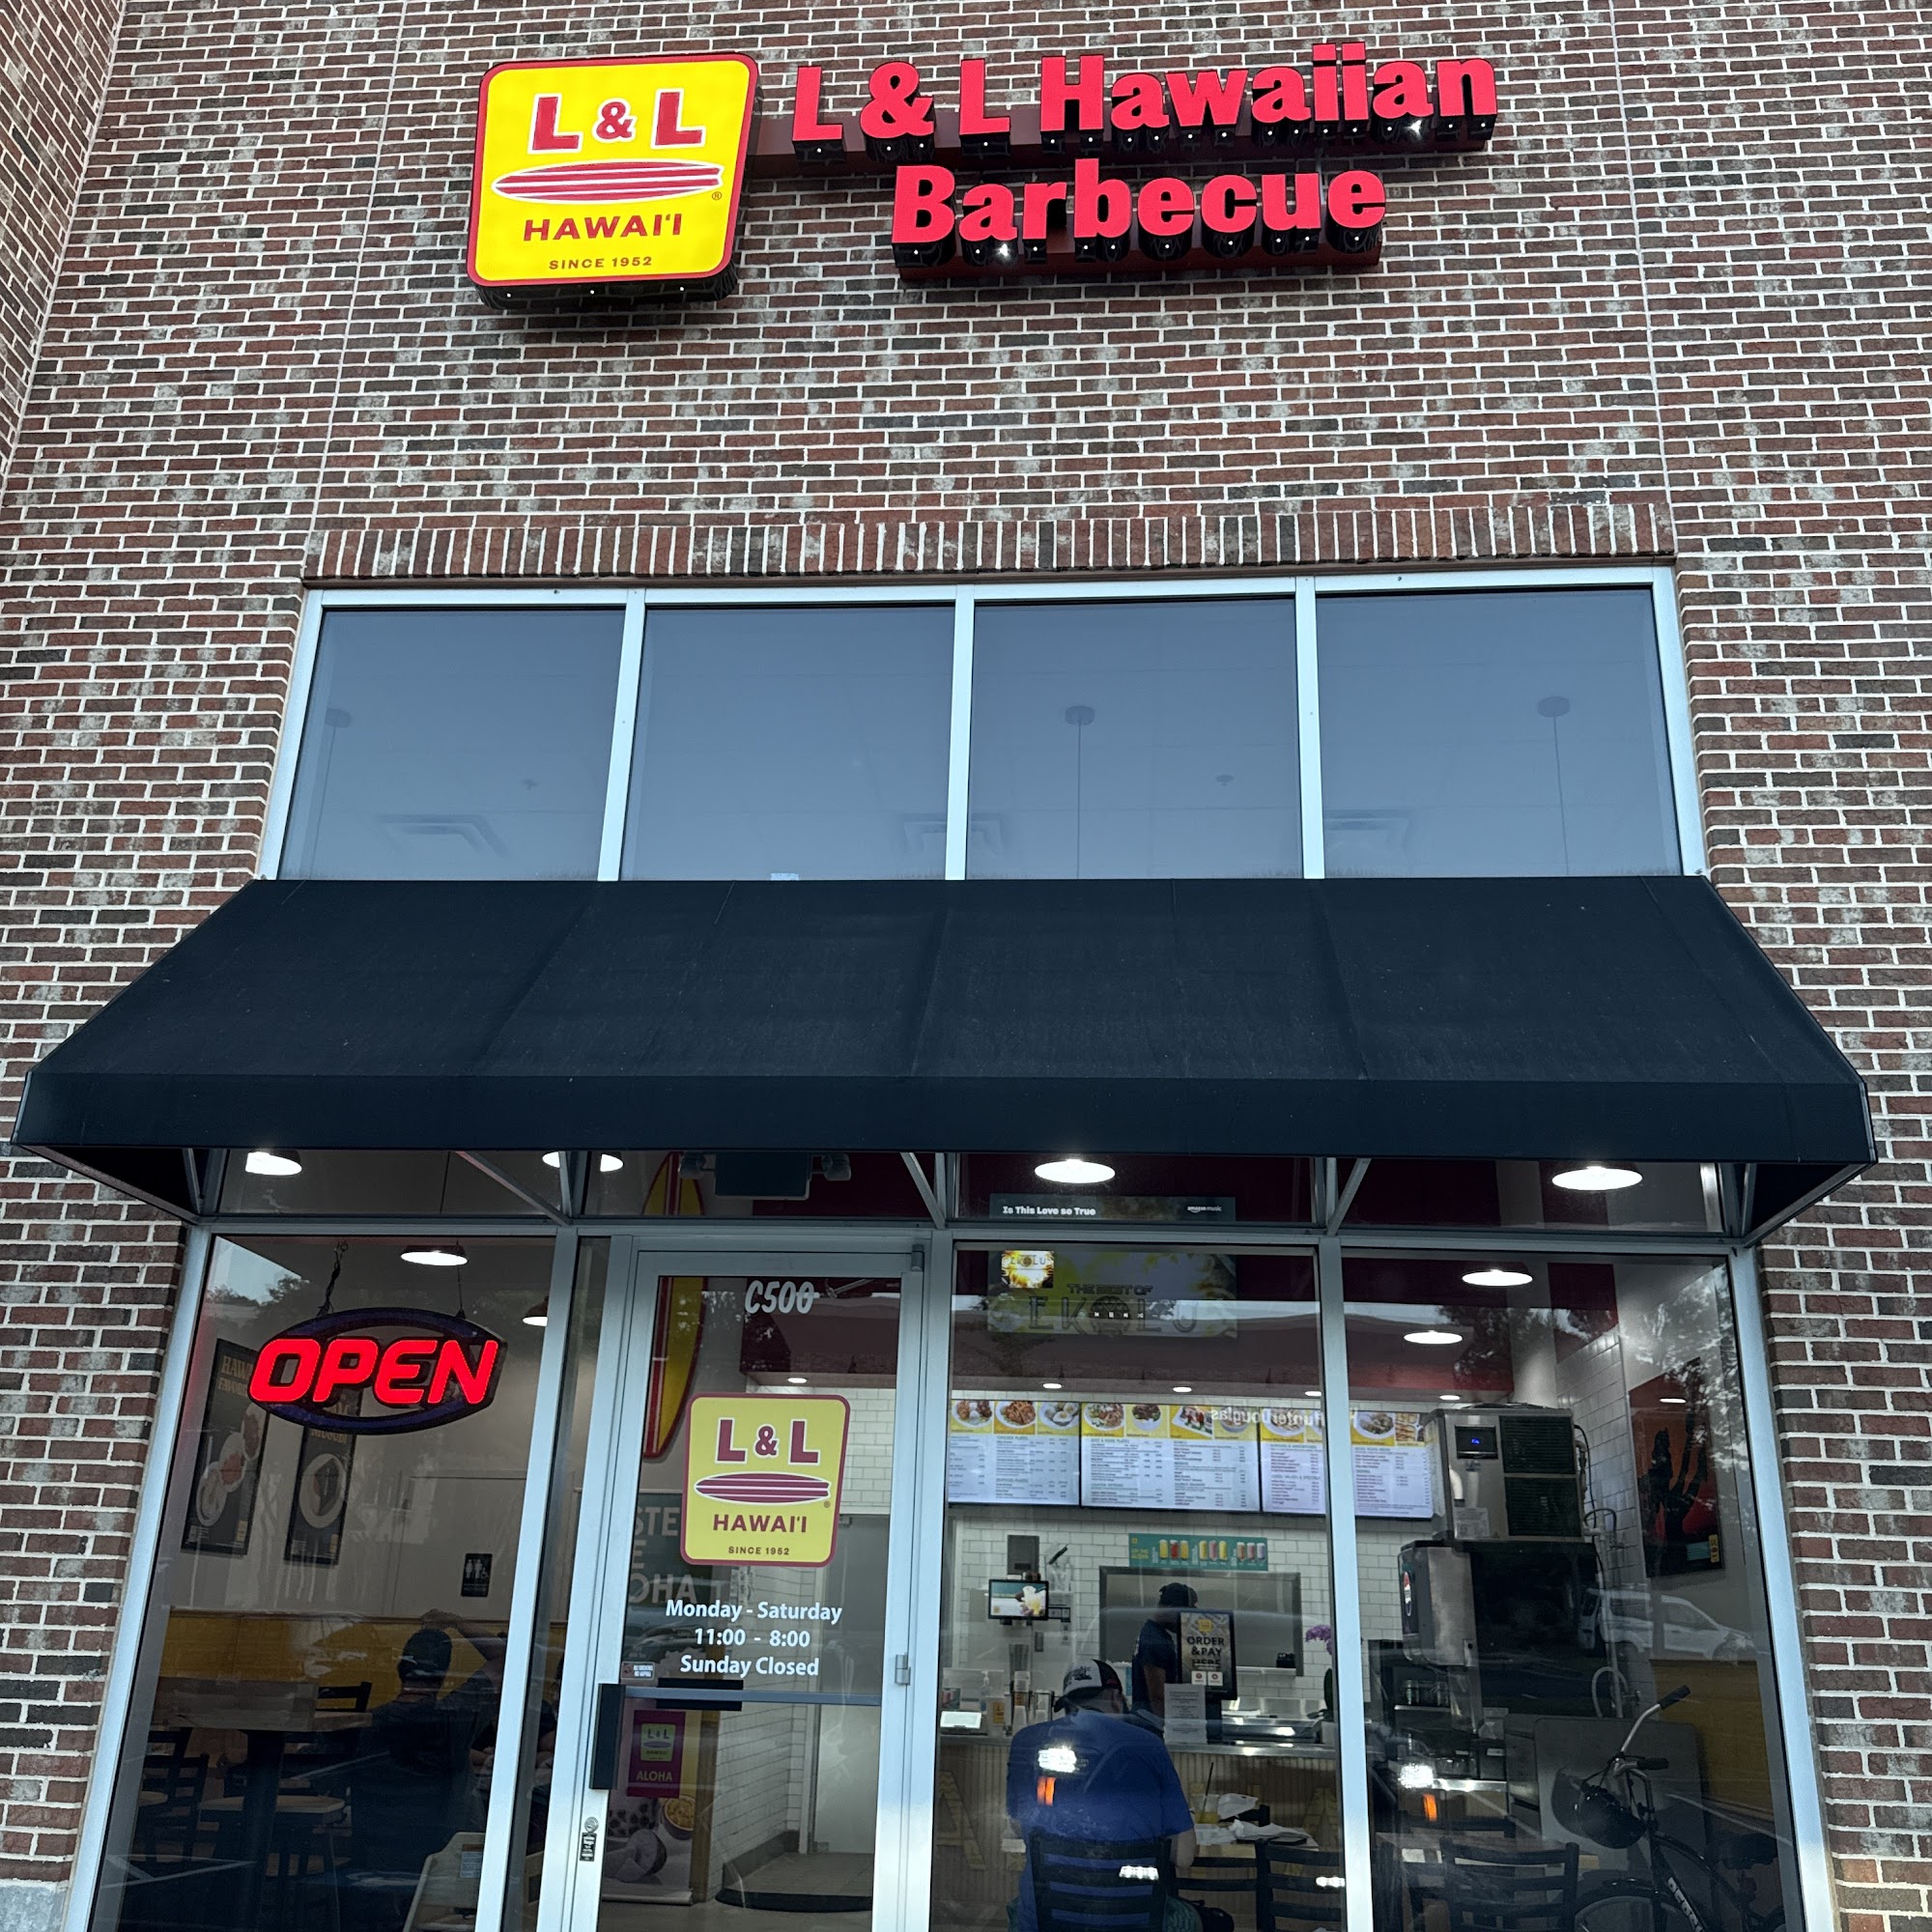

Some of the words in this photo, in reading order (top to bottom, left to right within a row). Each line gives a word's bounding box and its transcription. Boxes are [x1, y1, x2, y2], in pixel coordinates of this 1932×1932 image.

[1040, 42, 1497, 132] Hawaiian
[891, 157, 1386, 244] Barbecue
[549, 258, 605, 270] SINCE
[611, 255, 653, 268] 1952
[1003, 1206, 1013, 1214] Is
[1015, 1206, 1036, 1215] This
[1037, 1206, 1060, 1215] Love
[1061, 1208, 1073, 1216] so
[1074, 1207, 1096, 1216] True
[745, 1279, 815, 1315] C500
[1066, 1283, 1094, 1294] THE
[1134, 1285, 1154, 1295] OF
[248, 1338, 499, 1405] OPEN
[727, 1546, 762, 1555] SINCE
[765, 1547, 790, 1556] 1952
[665, 1599, 743, 1622] Monday
[756, 1601, 843, 1625] Saturday
[694, 1628, 746, 1646] 11:00
[769, 1630, 810, 1647] 8:00
[1187, 1635, 1225, 1646] ORDER
[679, 1654, 753, 1678] Sunday
[754, 1656, 820, 1676] Closed
[636, 1770, 673, 1782] ALOHA
